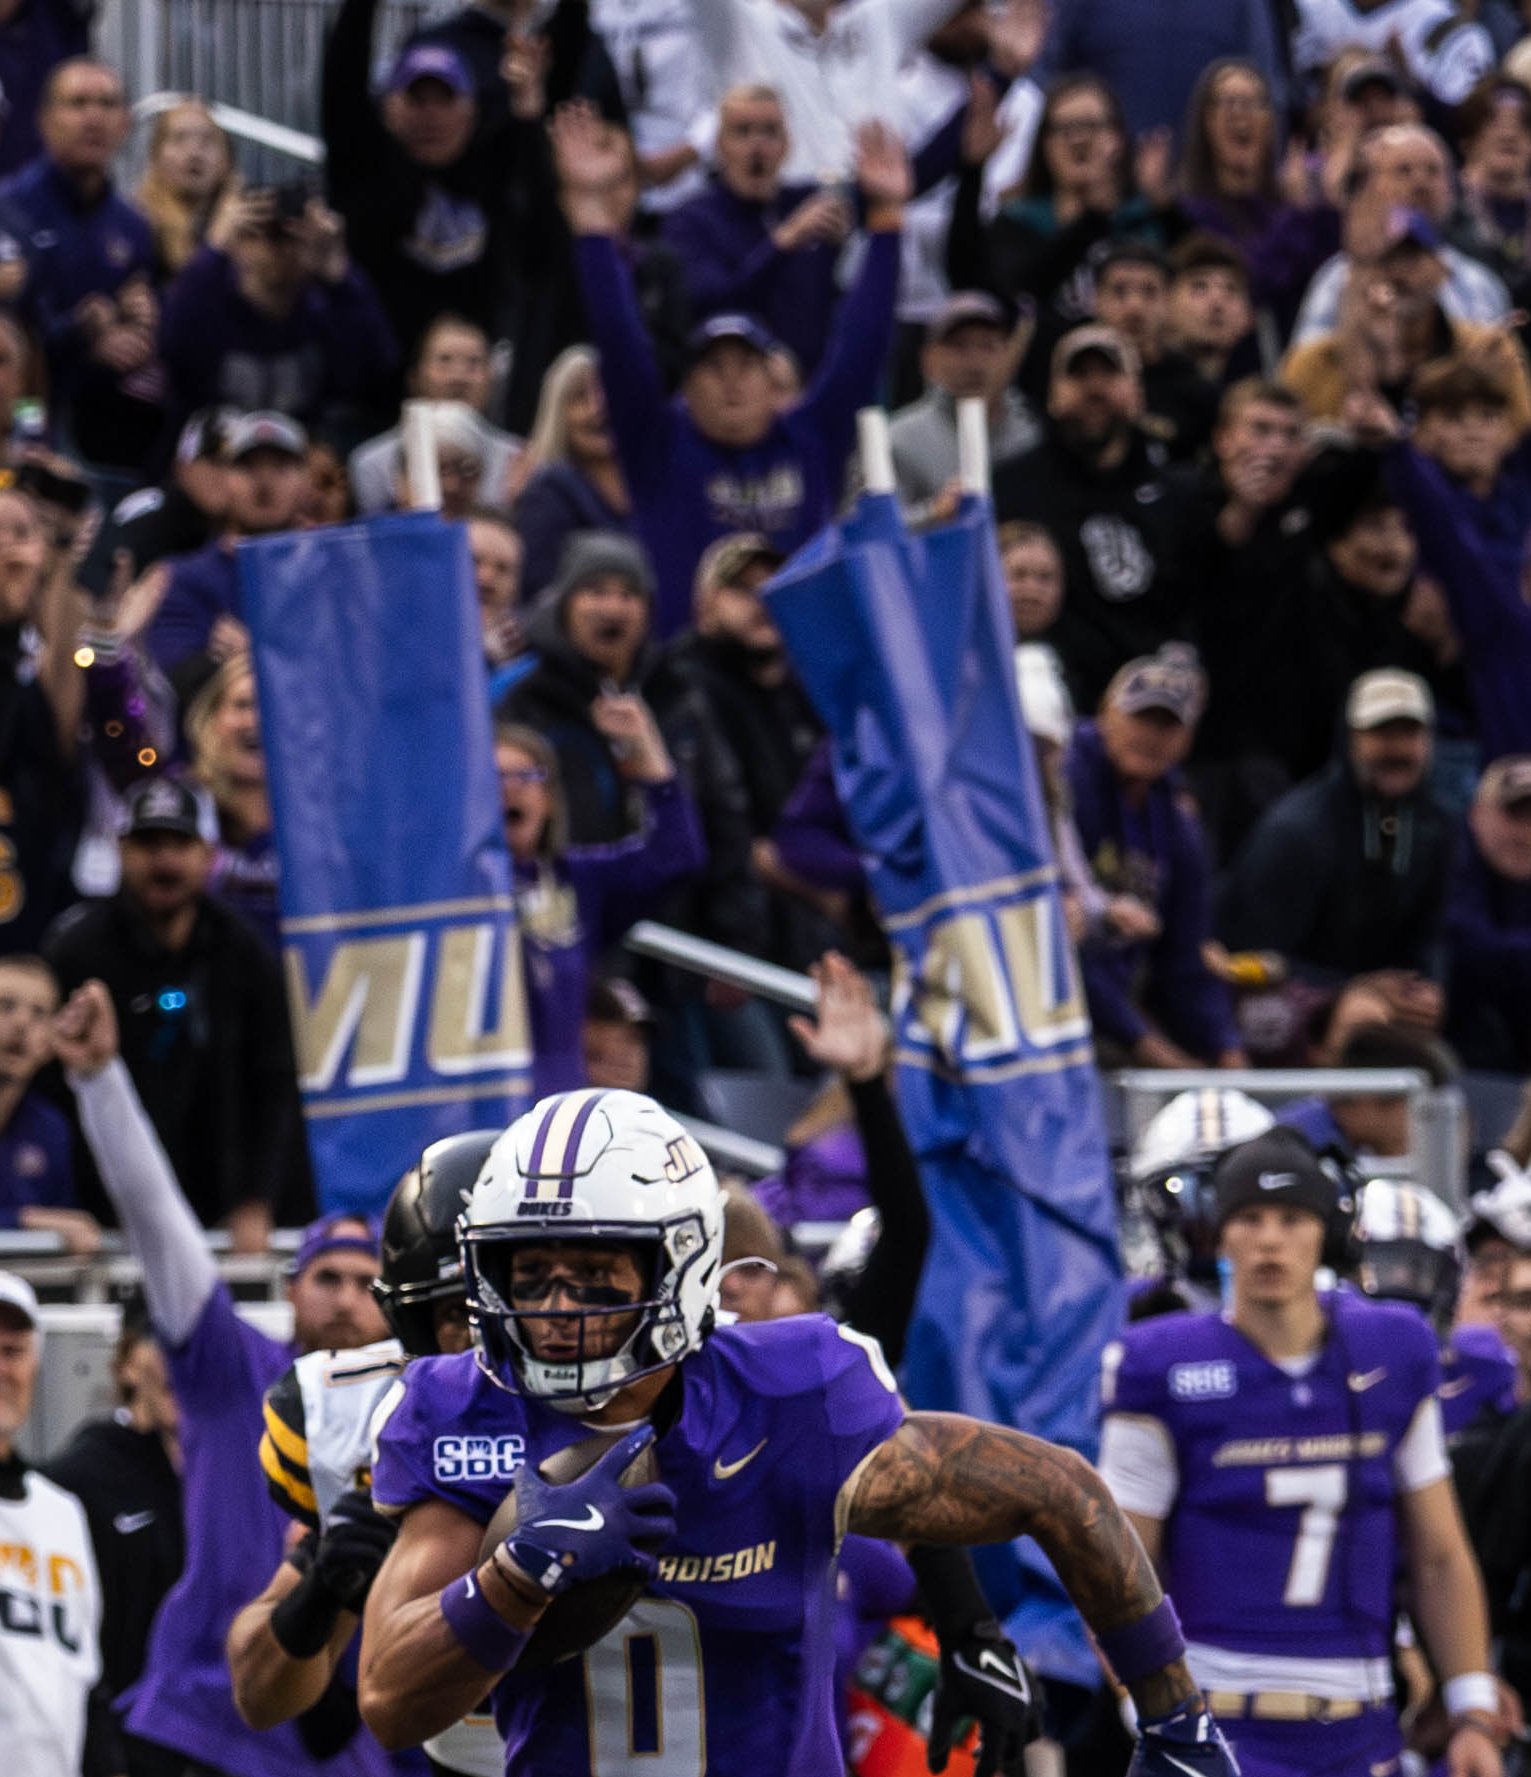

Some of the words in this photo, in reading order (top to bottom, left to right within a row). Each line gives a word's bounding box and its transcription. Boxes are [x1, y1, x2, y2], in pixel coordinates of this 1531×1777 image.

[516, 1201, 574, 1217] DUKES
[433, 1433, 527, 1481] SBC
[1265, 1463, 1347, 1608] 7
[657, 1539, 777, 1582] ADISON
